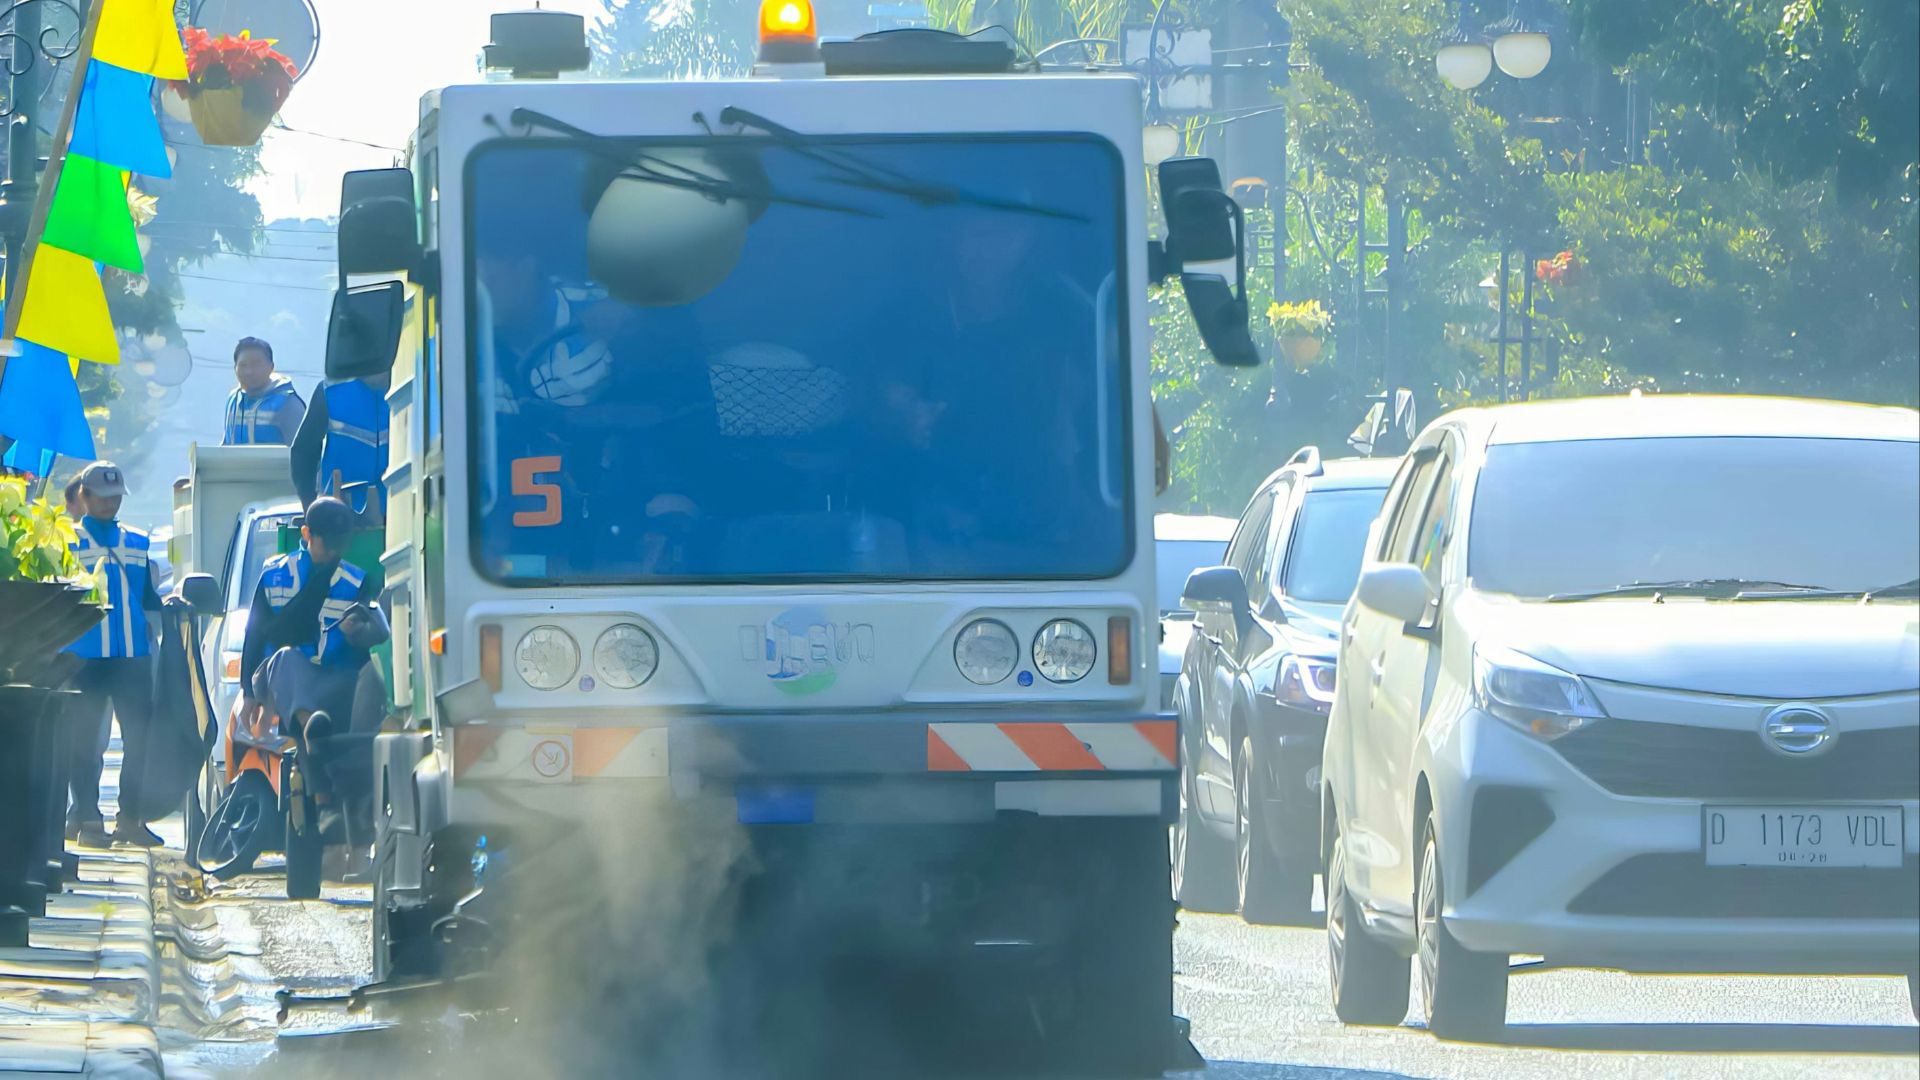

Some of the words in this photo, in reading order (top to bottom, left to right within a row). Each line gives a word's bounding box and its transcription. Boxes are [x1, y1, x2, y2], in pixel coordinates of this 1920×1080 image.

[511, 455, 562, 527] 5
[1711, 812, 1725, 846] D
[1760, 813, 1822, 846] 1173
[1846, 814, 1896, 847] VDL
